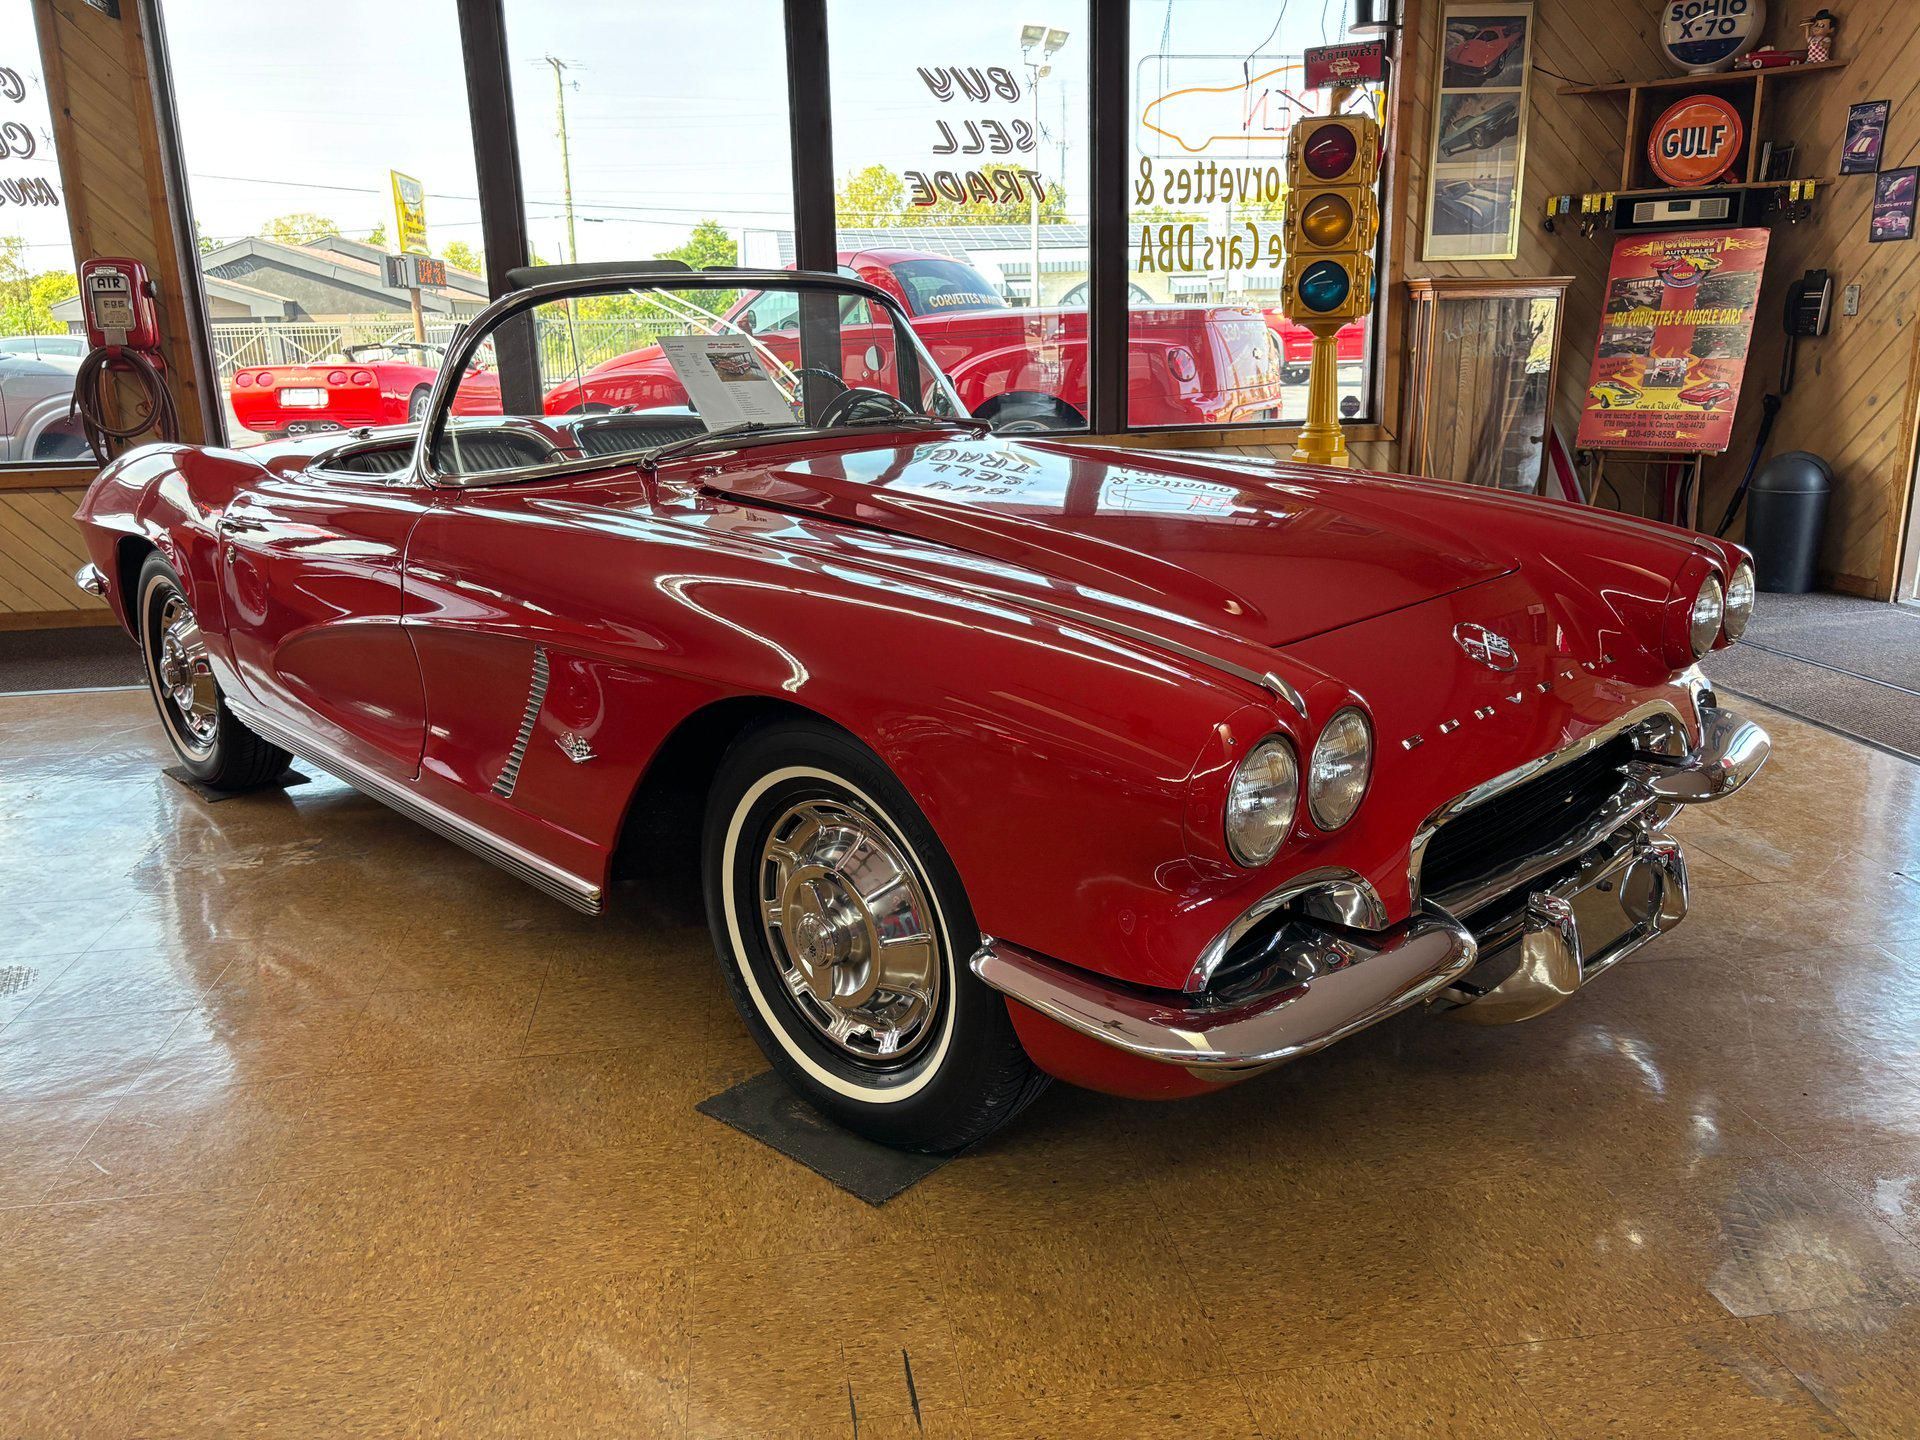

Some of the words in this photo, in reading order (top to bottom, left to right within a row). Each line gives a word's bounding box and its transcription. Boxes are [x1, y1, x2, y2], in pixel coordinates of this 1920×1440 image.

[1671, 0, 1747, 21] SOHIO
[1679, 18, 1736, 39] X-70
[1310, 48, 1379, 64] NORTHWEST
[1662, 125, 1728, 160] GULF
[1874, 200, 1912, 209] CORVETTE
[1688, 247, 1715, 255] SALES
[97, 277, 121, 289] AIR
[928, 292, 981, 310] CORVETTES
[1612, 311, 1627, 327] 150
[1628, 310, 1675, 327] CORVETTES
[1683, 309, 1719, 326] MUSCLE
[1719, 308, 1744, 325] CARS
[1663, 413, 1683, 421] Quaker
[1684, 413, 1700, 421] Steak
[1581, 438, 1722, 449] www.northwestautosales.com
